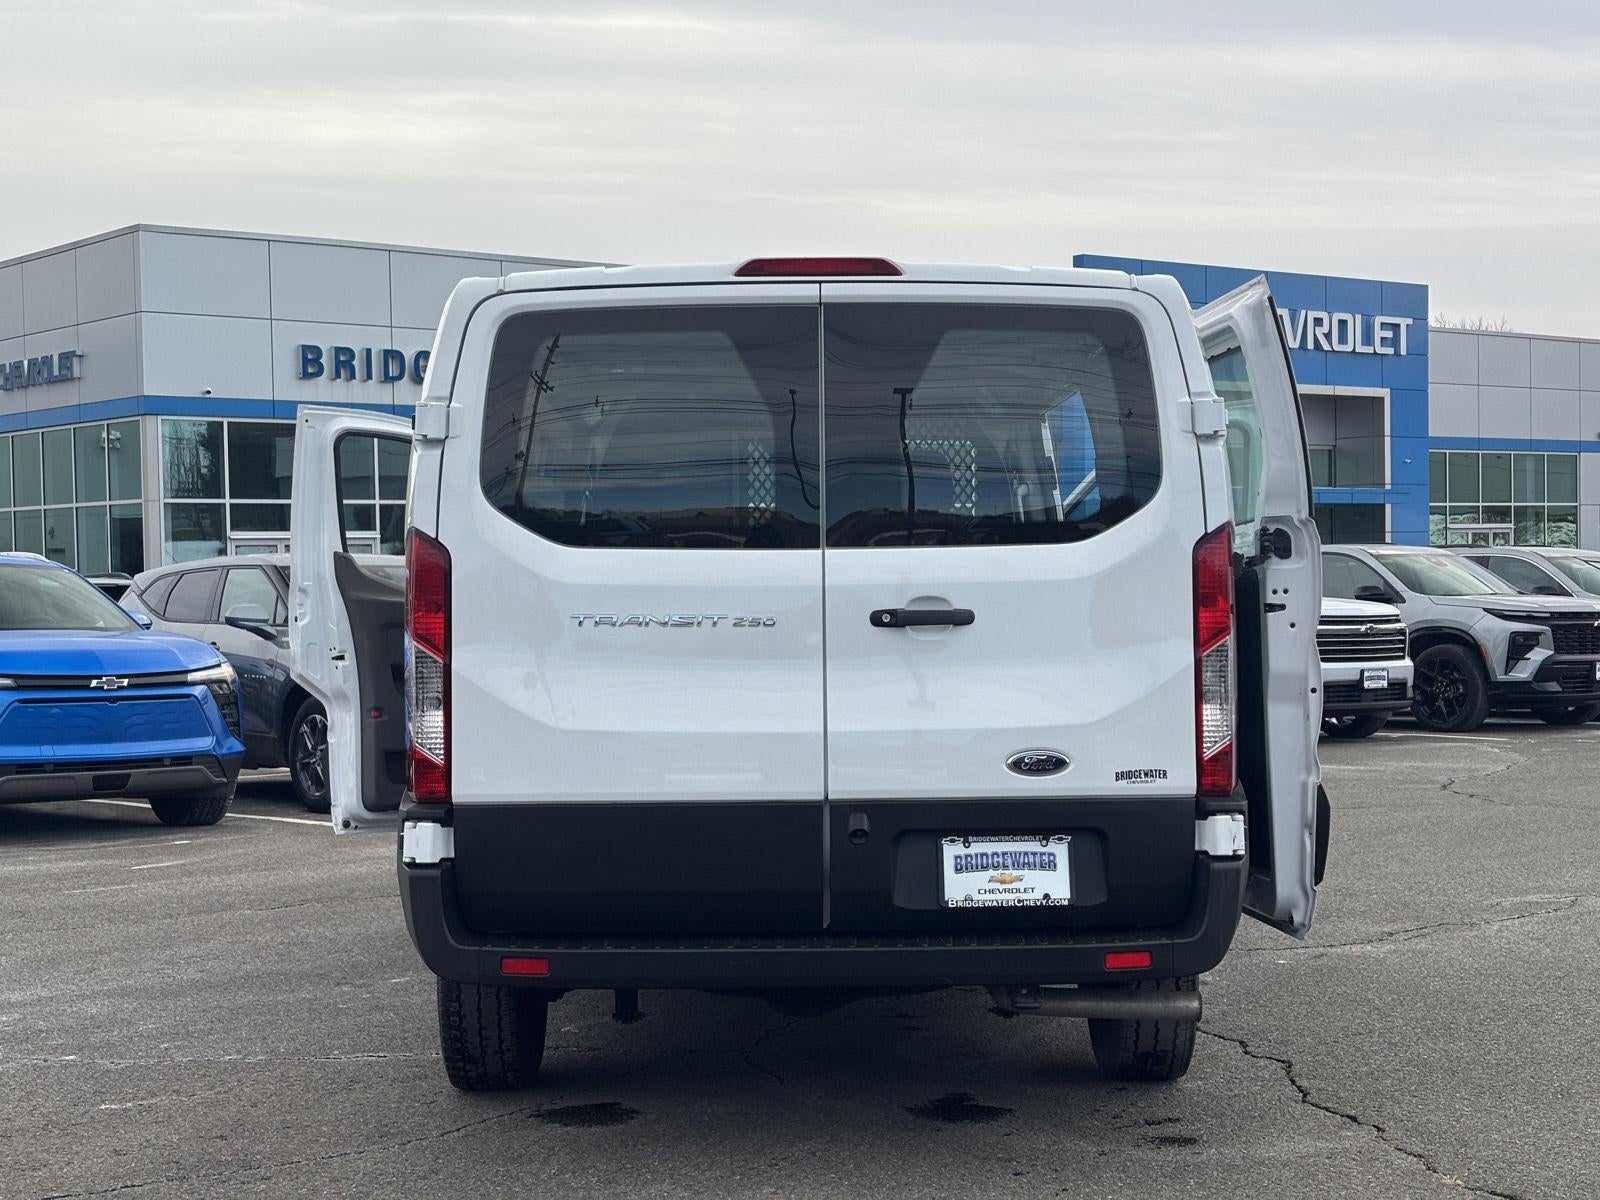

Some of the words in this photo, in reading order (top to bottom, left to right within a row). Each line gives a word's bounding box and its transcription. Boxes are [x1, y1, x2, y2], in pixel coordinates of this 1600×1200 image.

[1277, 307, 1413, 356] VROLET
[570, 613, 728, 628] TRANSIT
[732, 616, 777, 628] 250
[1021, 755, 1056, 770] Ford
[1115, 768, 1168, 782] BRIDGEWATER
[953, 850, 1057, 874] BRIDGEWATER
[977, 886, 1036, 896] CHEVROLET
